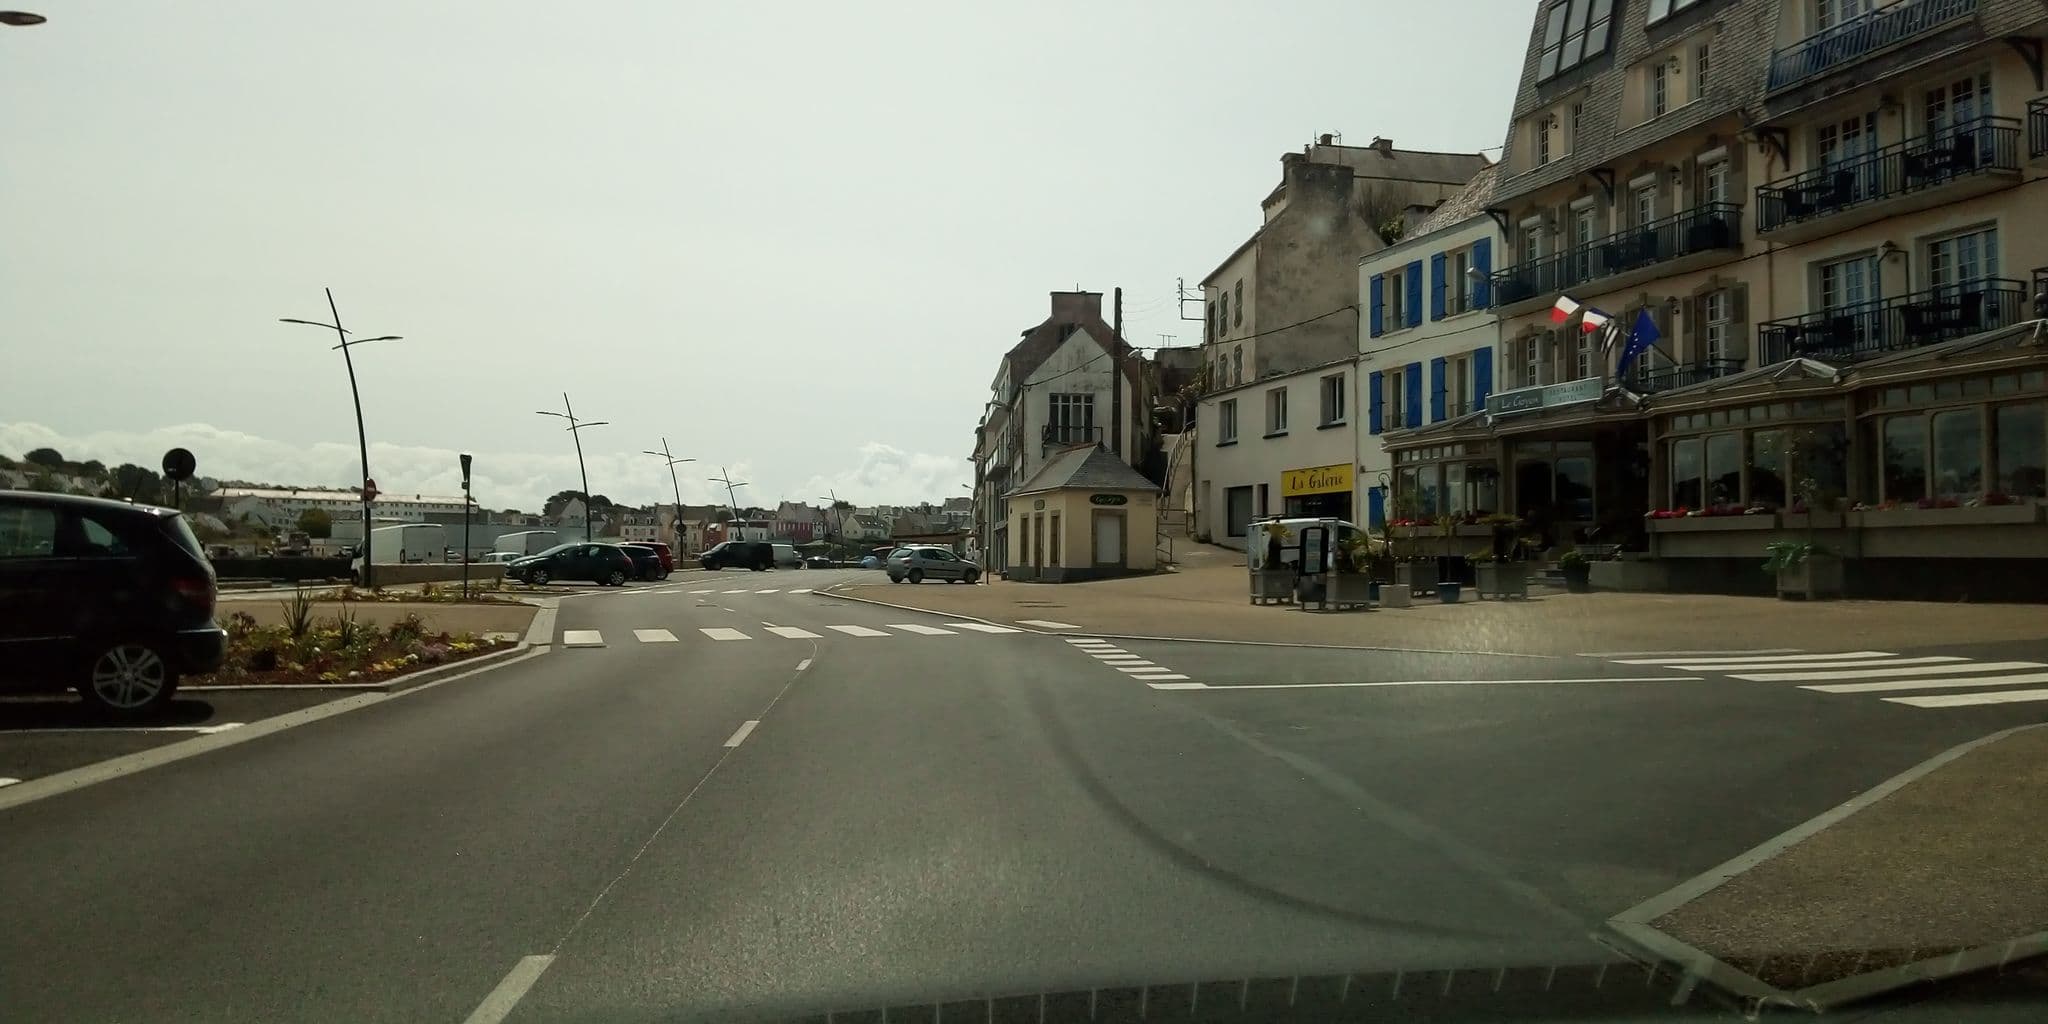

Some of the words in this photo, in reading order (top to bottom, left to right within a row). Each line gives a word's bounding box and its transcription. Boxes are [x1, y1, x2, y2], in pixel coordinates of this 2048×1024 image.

[1501, 399, 1512, 409] Le
[1290, 476, 1304, 490] La
[1309, 472, 1344, 489] Galerie
